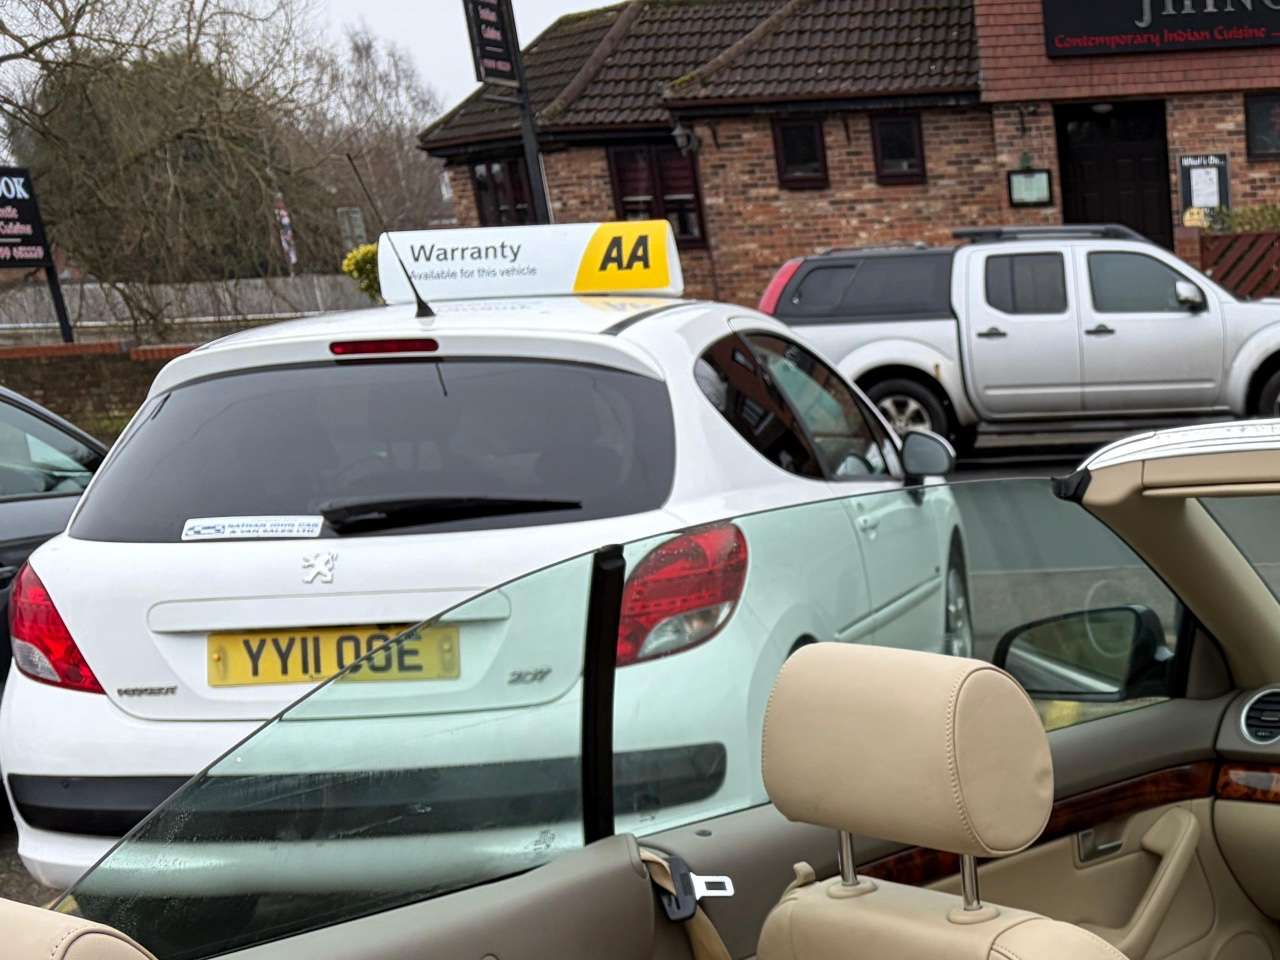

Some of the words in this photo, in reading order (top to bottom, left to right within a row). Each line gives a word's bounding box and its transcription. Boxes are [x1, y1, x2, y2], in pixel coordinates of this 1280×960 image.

[1055, 31, 1160, 48] Contemporary
[1164, 28, 1211, 43] Indian
[1214, 25, 1268, 40] Cuisine
[410, 241, 522, 263] Warranty
[599, 235, 650, 271] AA
[410, 268, 457, 281] Available
[460, 267, 475, 279] for
[477, 266, 497, 278] this
[499, 265, 537, 277] vehicle
[242, 635, 322, 677] YY11
